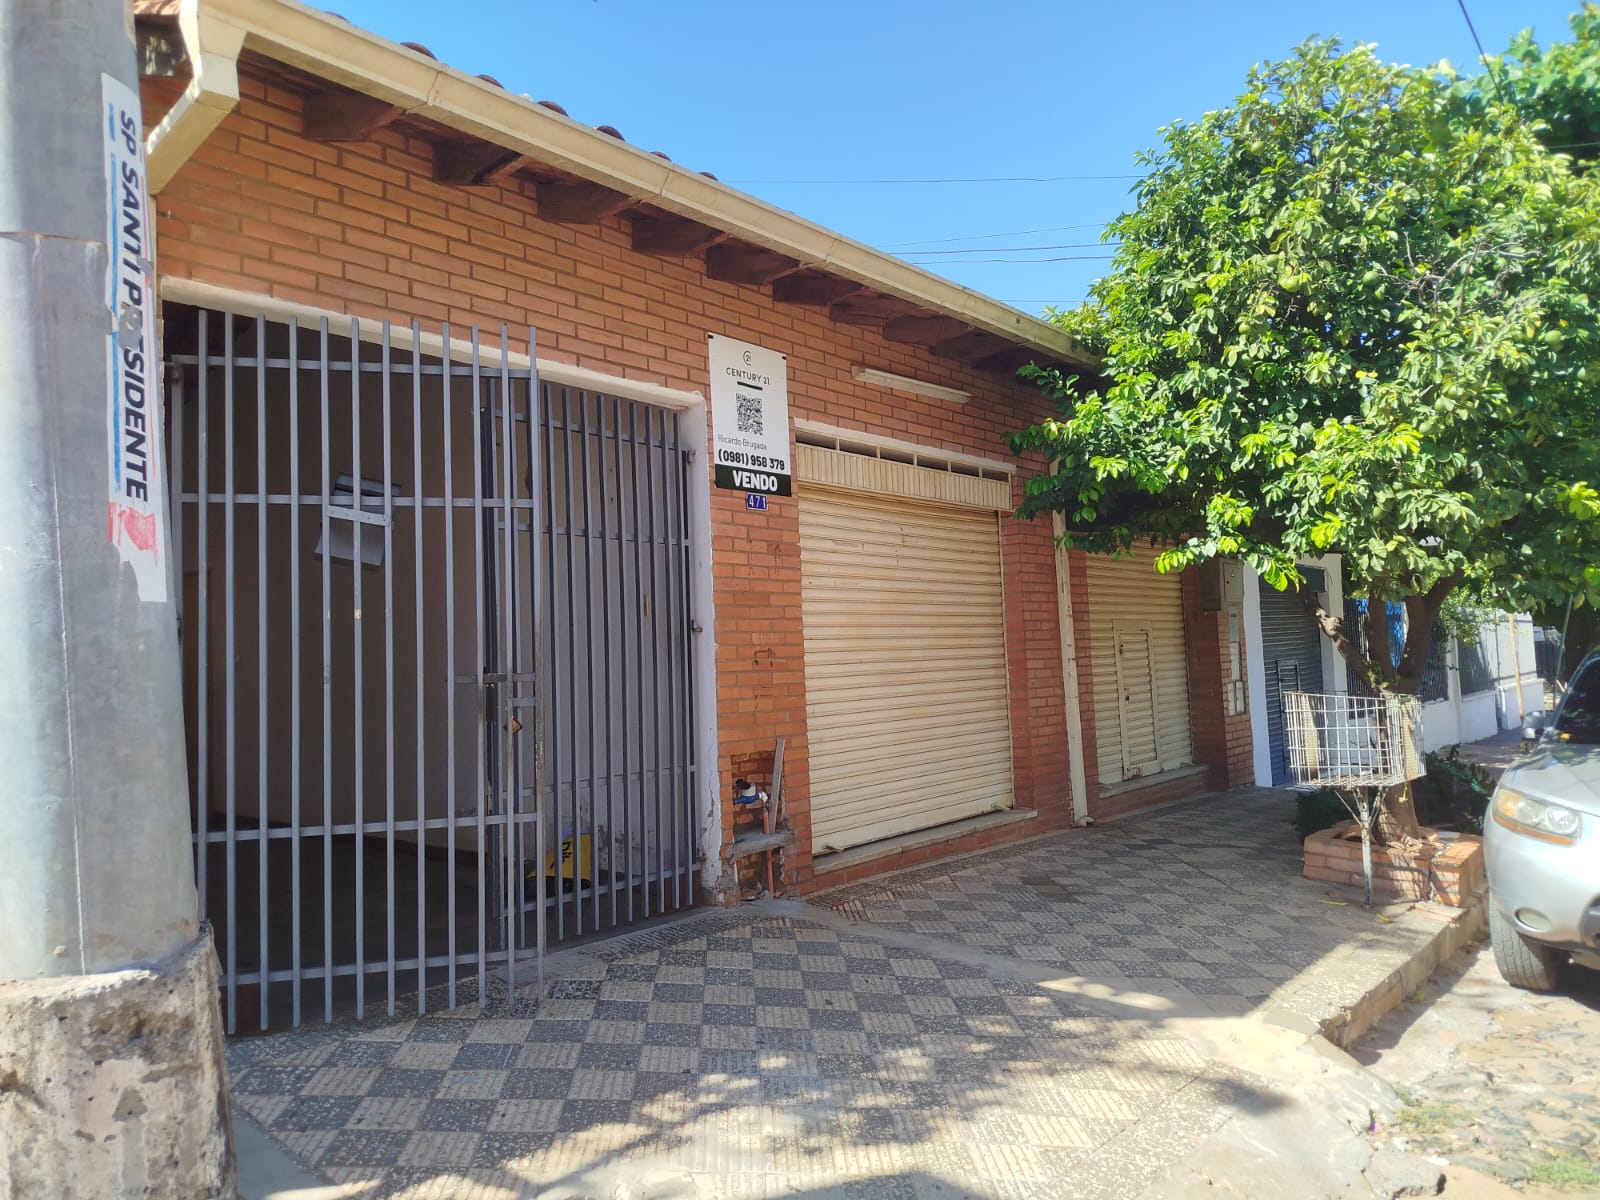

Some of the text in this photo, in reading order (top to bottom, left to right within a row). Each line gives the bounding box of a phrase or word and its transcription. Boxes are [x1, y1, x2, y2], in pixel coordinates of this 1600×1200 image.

[120, 110, 136, 156] SP
[726, 367, 770, 385] CENTURY 21
[122, 277, 148, 503] PSIDENTE
[718, 434, 742, 446] Ricardo
[718, 448, 785, 471] (0981) 958 379
[732, 469, 778, 492] VENDO
[749, 494, 766, 509] 471
